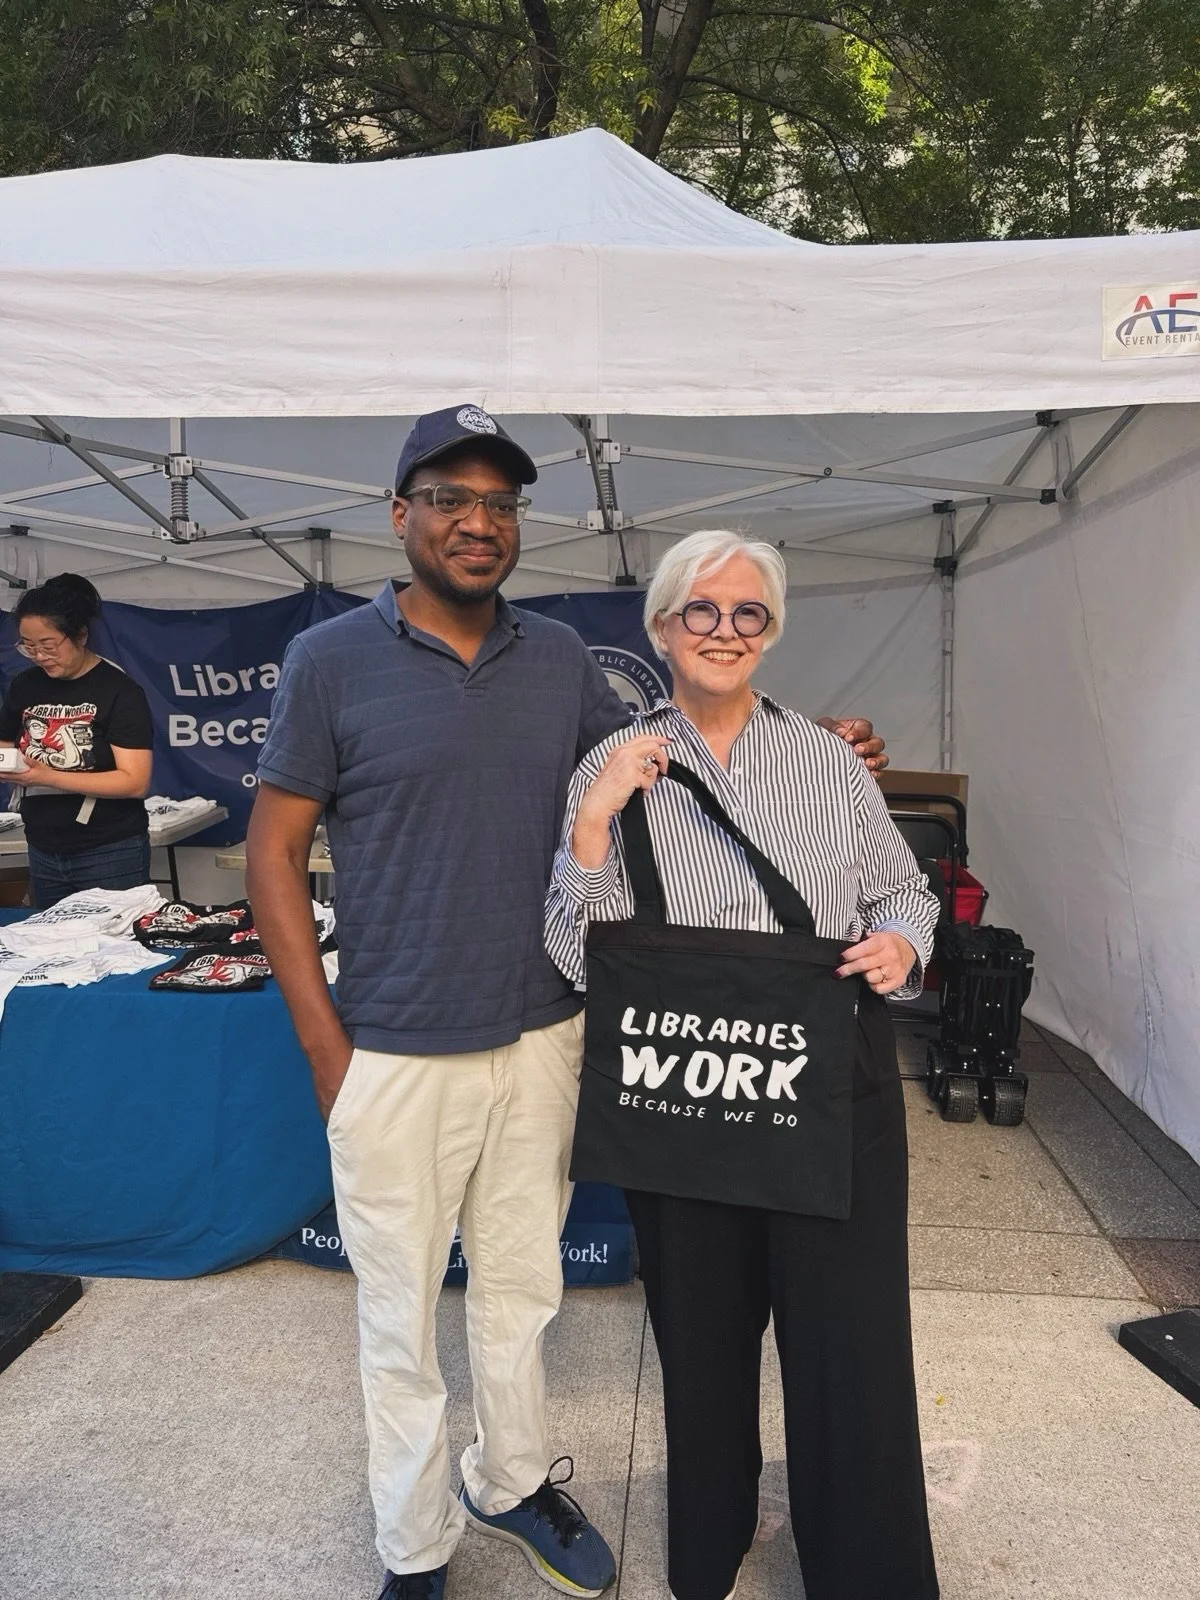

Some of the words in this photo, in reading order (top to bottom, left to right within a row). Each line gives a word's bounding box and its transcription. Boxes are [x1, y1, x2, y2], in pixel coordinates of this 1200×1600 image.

[1125, 335, 1160, 346] EVENT
[27, 705, 63, 718] LIBRARY
[64, 704, 96, 717] WORKERS
[620, 1006, 807, 1051] LIBRARIES
[620, 1045, 809, 1102] WORK
[619, 1092, 707, 1119] BECAUSE
[724, 1110, 756, 1123] WE
[772, 1112, 798, 1128] DO
